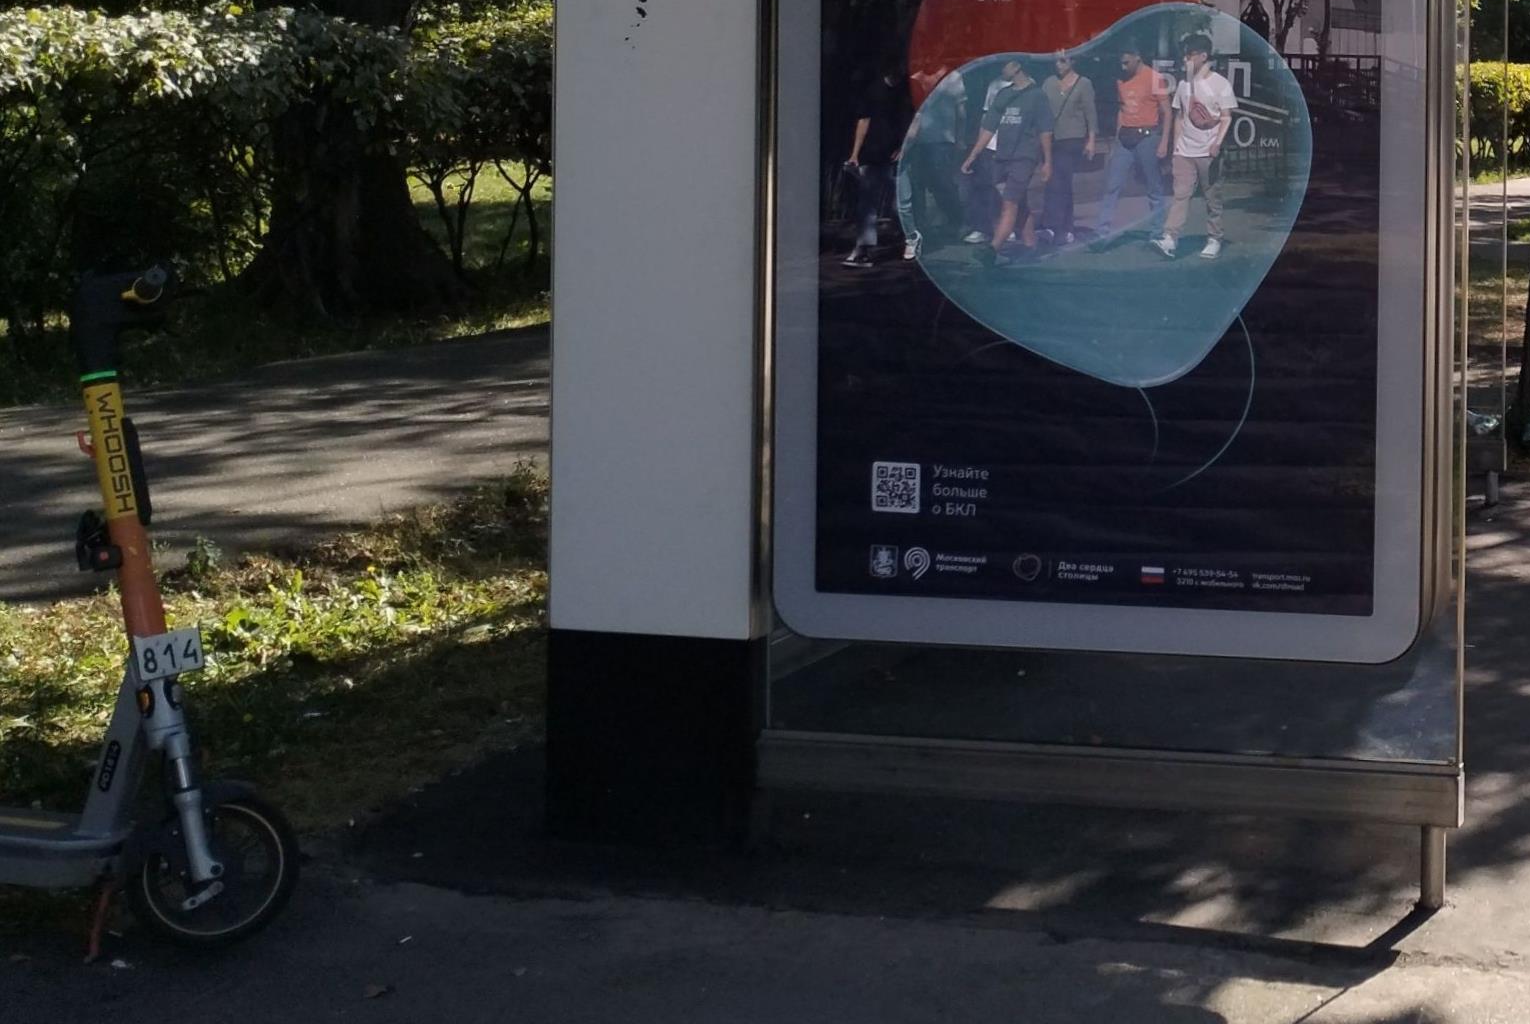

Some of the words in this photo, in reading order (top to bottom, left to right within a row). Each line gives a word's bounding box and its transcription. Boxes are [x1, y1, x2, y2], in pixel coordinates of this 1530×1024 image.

[1152, 59, 1252, 98] БЛ
[1260, 137, 1280, 148] км
[96, 392, 135, 514] WHOOSH
[932, 464, 990, 481] Узнайте
[932, 483, 988, 498] больше
[932, 504, 942, 515] о
[945, 502, 977, 517] БКЛ
[142, 638, 199, 674] 814
